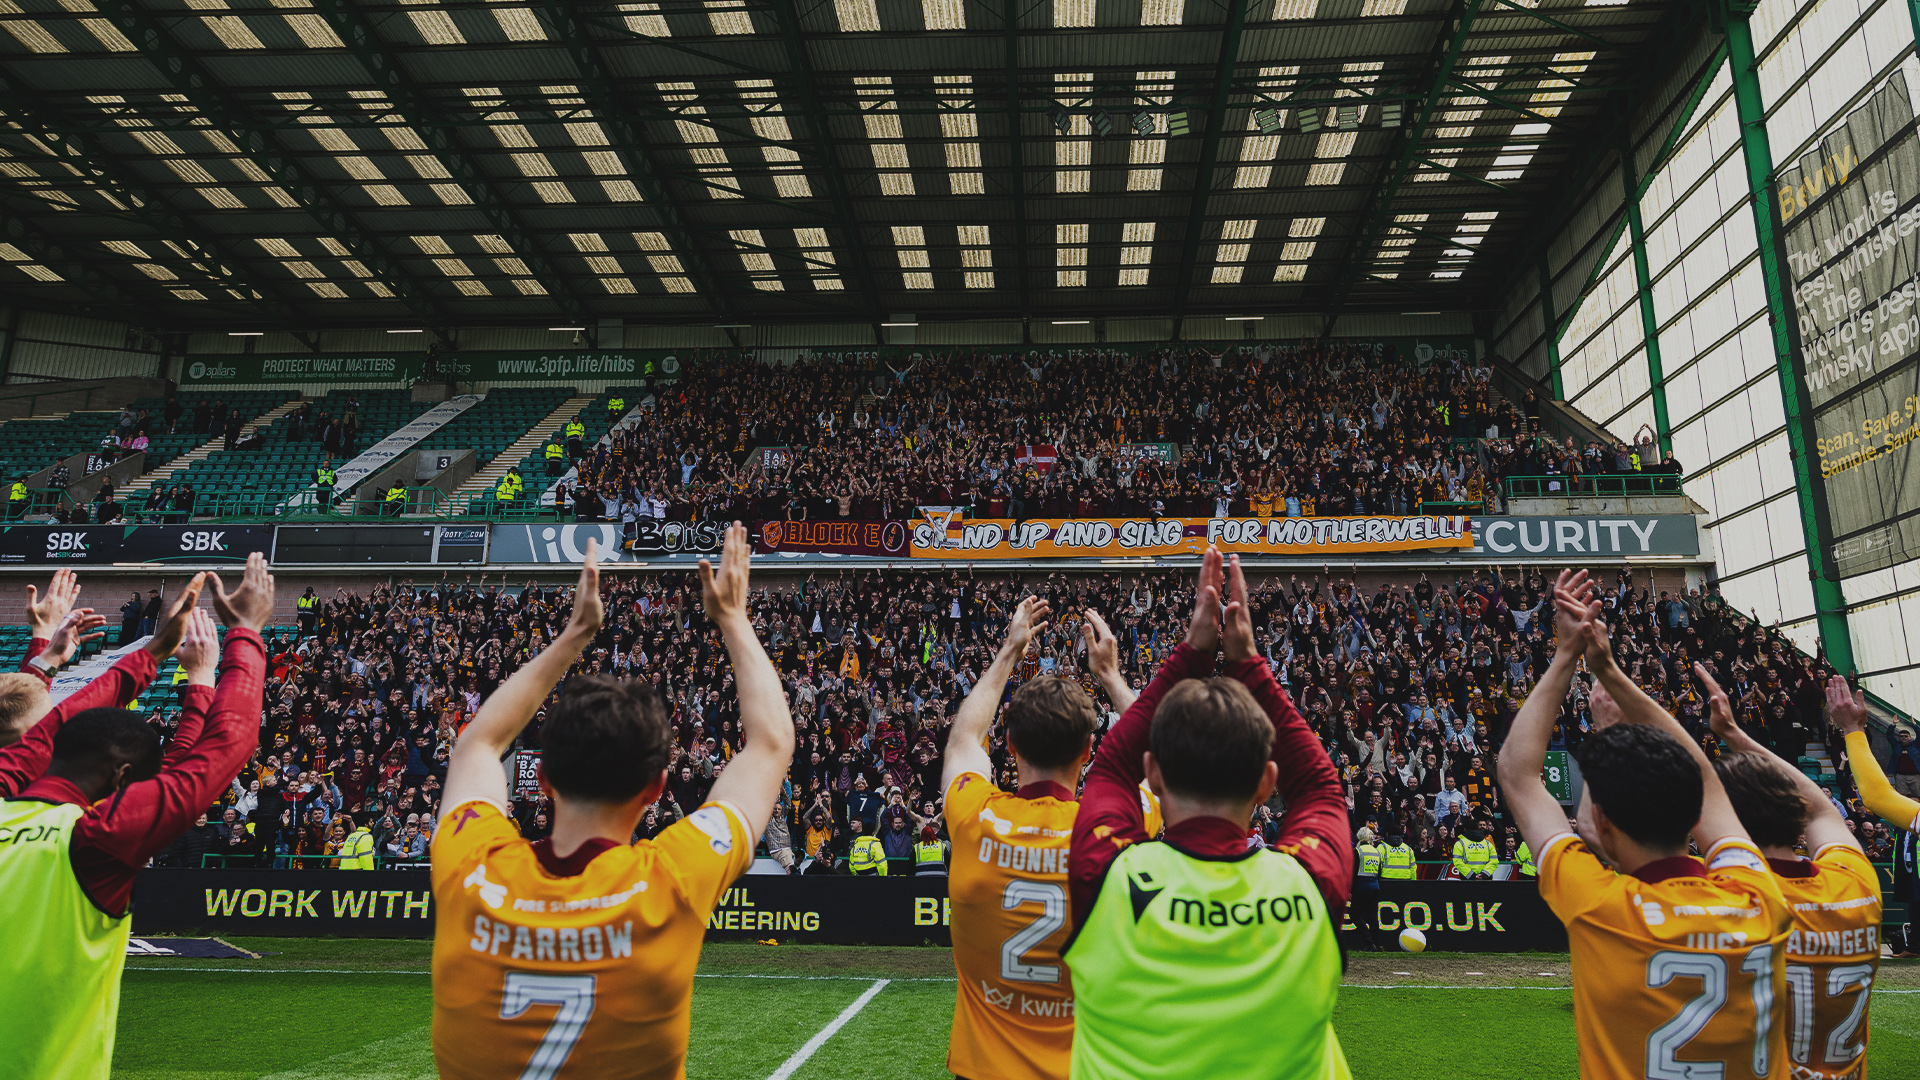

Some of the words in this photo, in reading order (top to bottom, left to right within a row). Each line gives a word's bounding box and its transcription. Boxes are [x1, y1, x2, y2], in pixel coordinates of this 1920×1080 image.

[1787, 246, 1822, 276] The
[1824, 190, 1898, 257] world's
[1800, 310, 1874, 364] world's
[1877, 271, 1920, 324] best
[1822, 287, 1862, 321] the
[263, 359, 311, 372] PROTECT
[313, 359, 343, 372] WHAT
[346, 358, 396, 371] MATTERS
[498, 355, 635, 375] www.3pfp.life/hibs
[1803, 340, 1874, 393] whisky
[1879, 314, 1920, 356] app
[1816, 431, 1859, 457] Scan.
[1862, 410, 1903, 440] Save.
[440, 458, 448, 467] 3
[1820, 444, 1883, 479] Sample.
[46, 532, 87, 550] SBK
[180, 531, 226, 551] SBK
[783, 521, 858, 546] BLOCK
[864, 523, 881, 547] E
[912, 522, 1004, 550] SND
[1008, 521, 1051, 550] UP
[1054, 521, 1115, 548] AND
[1117, 520, 1183, 549] SING
[1207, 518, 1264, 545] FOR
[1267, 515, 1466, 546] MOTHERWELL!
[1459, 519, 1658, 552] ECURITY
[1548, 766, 1561, 783] 8
[859, 797, 868, 812] 7
[205, 888, 322, 918] WORK
[331, 890, 430, 919] WITH
[513, 897, 546, 913] FIRE
[1169, 893, 1313, 927] macron
[1794, 902, 1819, 912] FIRE
[469, 914, 633, 962] SPARROW
[1000, 879, 1067, 983] 2
[498, 971, 597, 1080] 7
[1645, 943, 1775, 1080] 21
[1785, 962, 1875, 1065] 12
